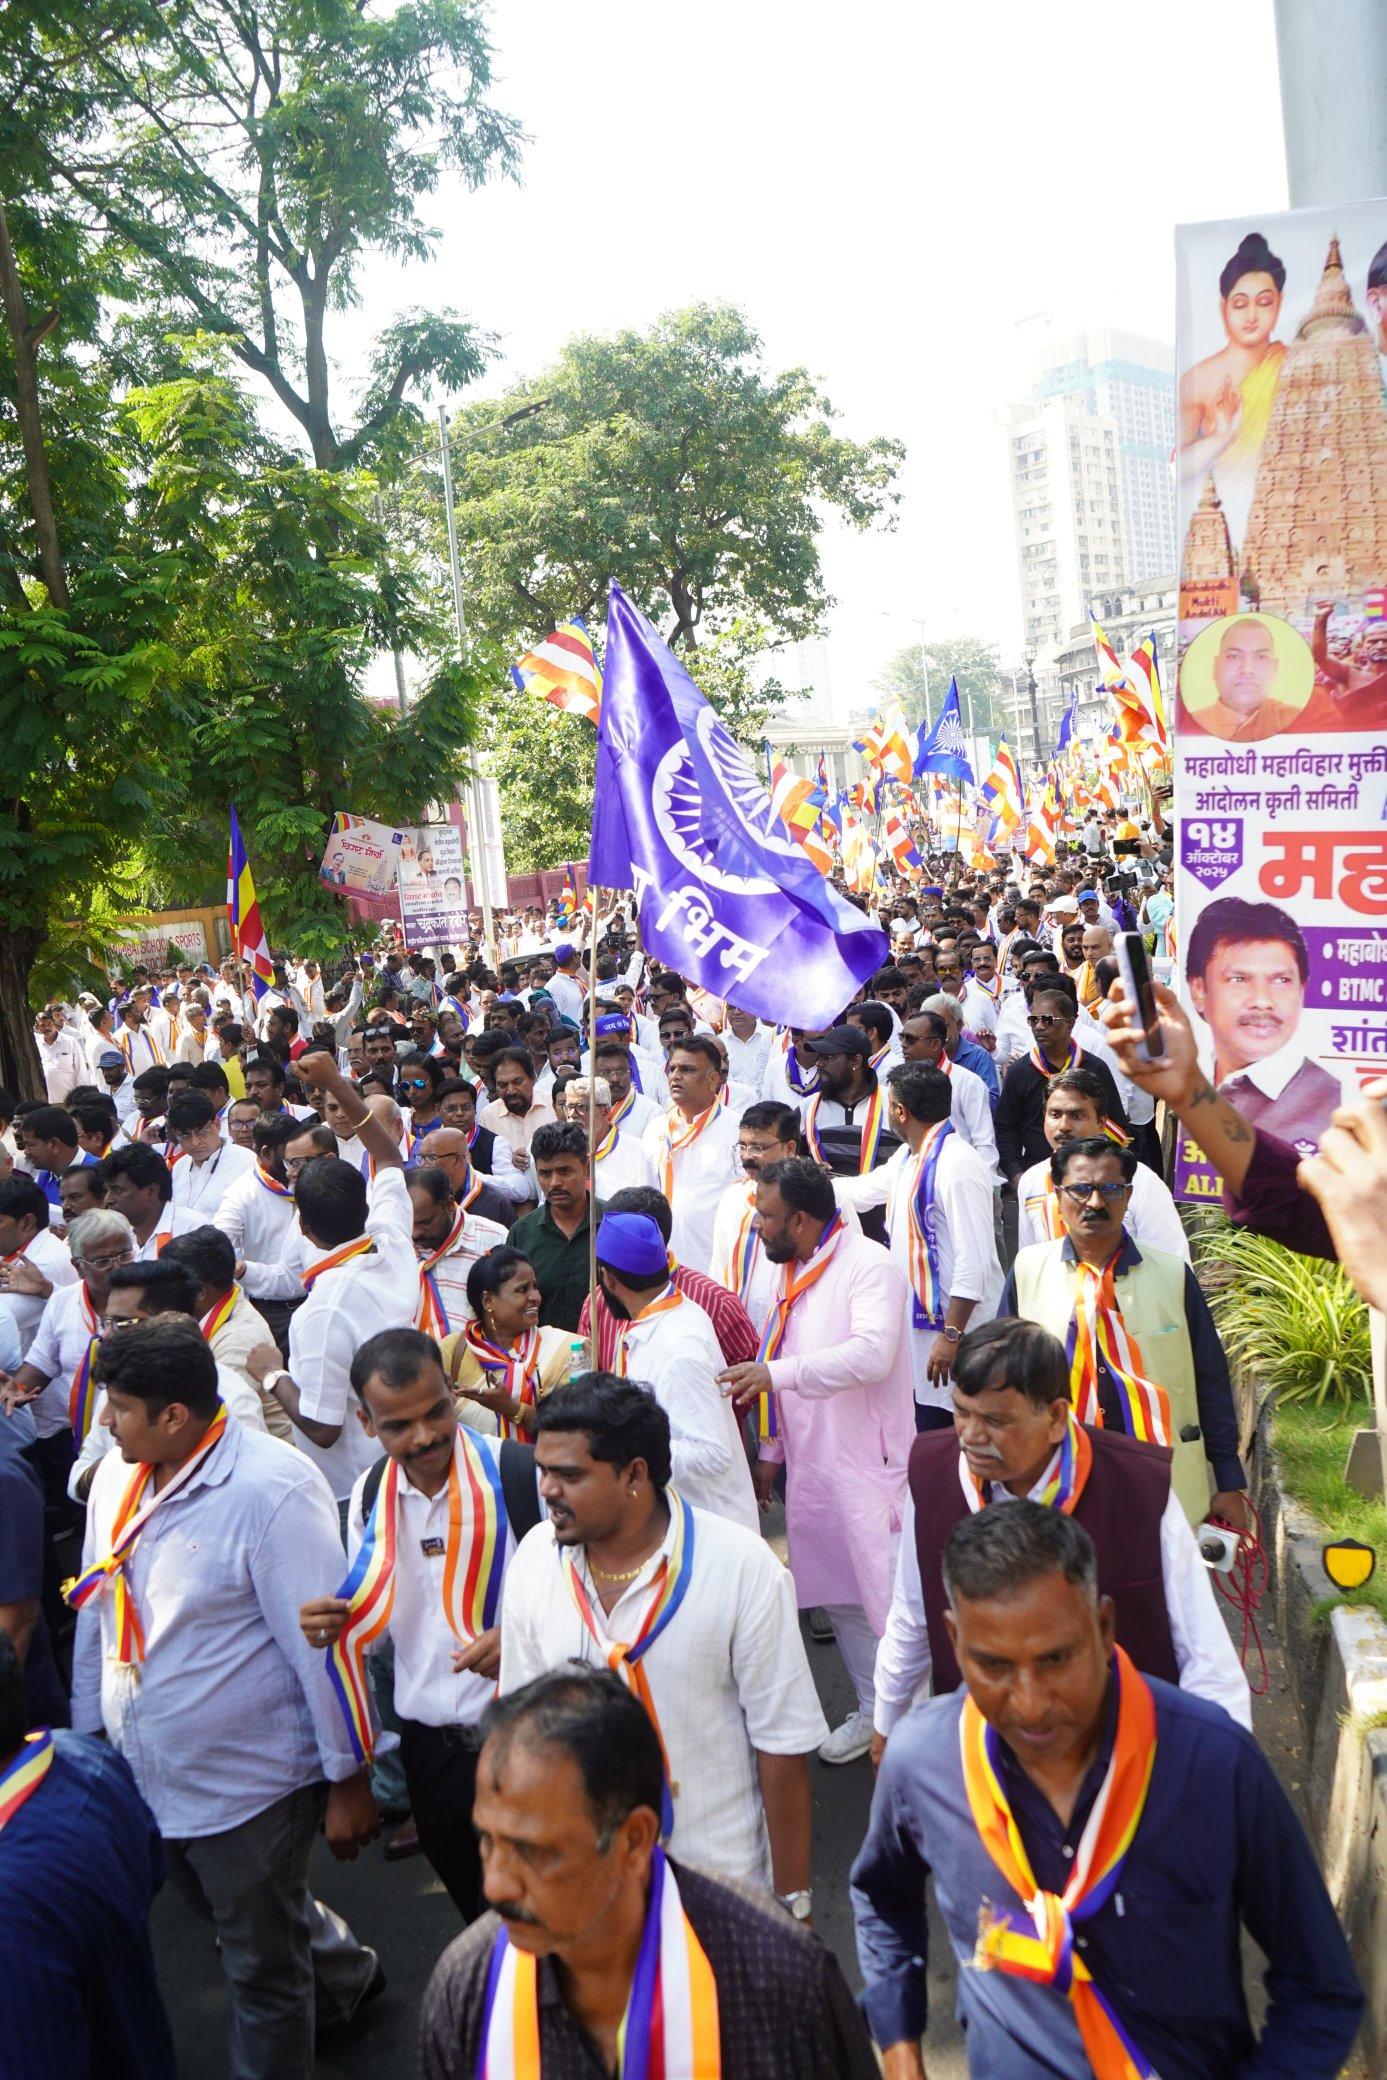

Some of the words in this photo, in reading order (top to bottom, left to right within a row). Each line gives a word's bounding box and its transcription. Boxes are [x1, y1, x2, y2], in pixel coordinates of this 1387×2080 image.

[1191, 596, 1219, 607] Mukti
[1184, 749, 1257, 779] महाबोधी
[1261, 748, 1343, 778] महाविहार
[1195, 785, 1261, 813] आंदोलन
[1265, 784, 1301, 819] कृती
[1305, 784, 1359, 810] समिती
[1187, 822, 1237, 848] १४
[1186, 849, 1239, 864] ऑक्टोबर
[1195, 866, 1228, 878] २०२५
[175, 932, 201, 949] SPORTS
[655, 885, 770, 983] भिम
[1338, 977, 1384, 1003] BTMC
